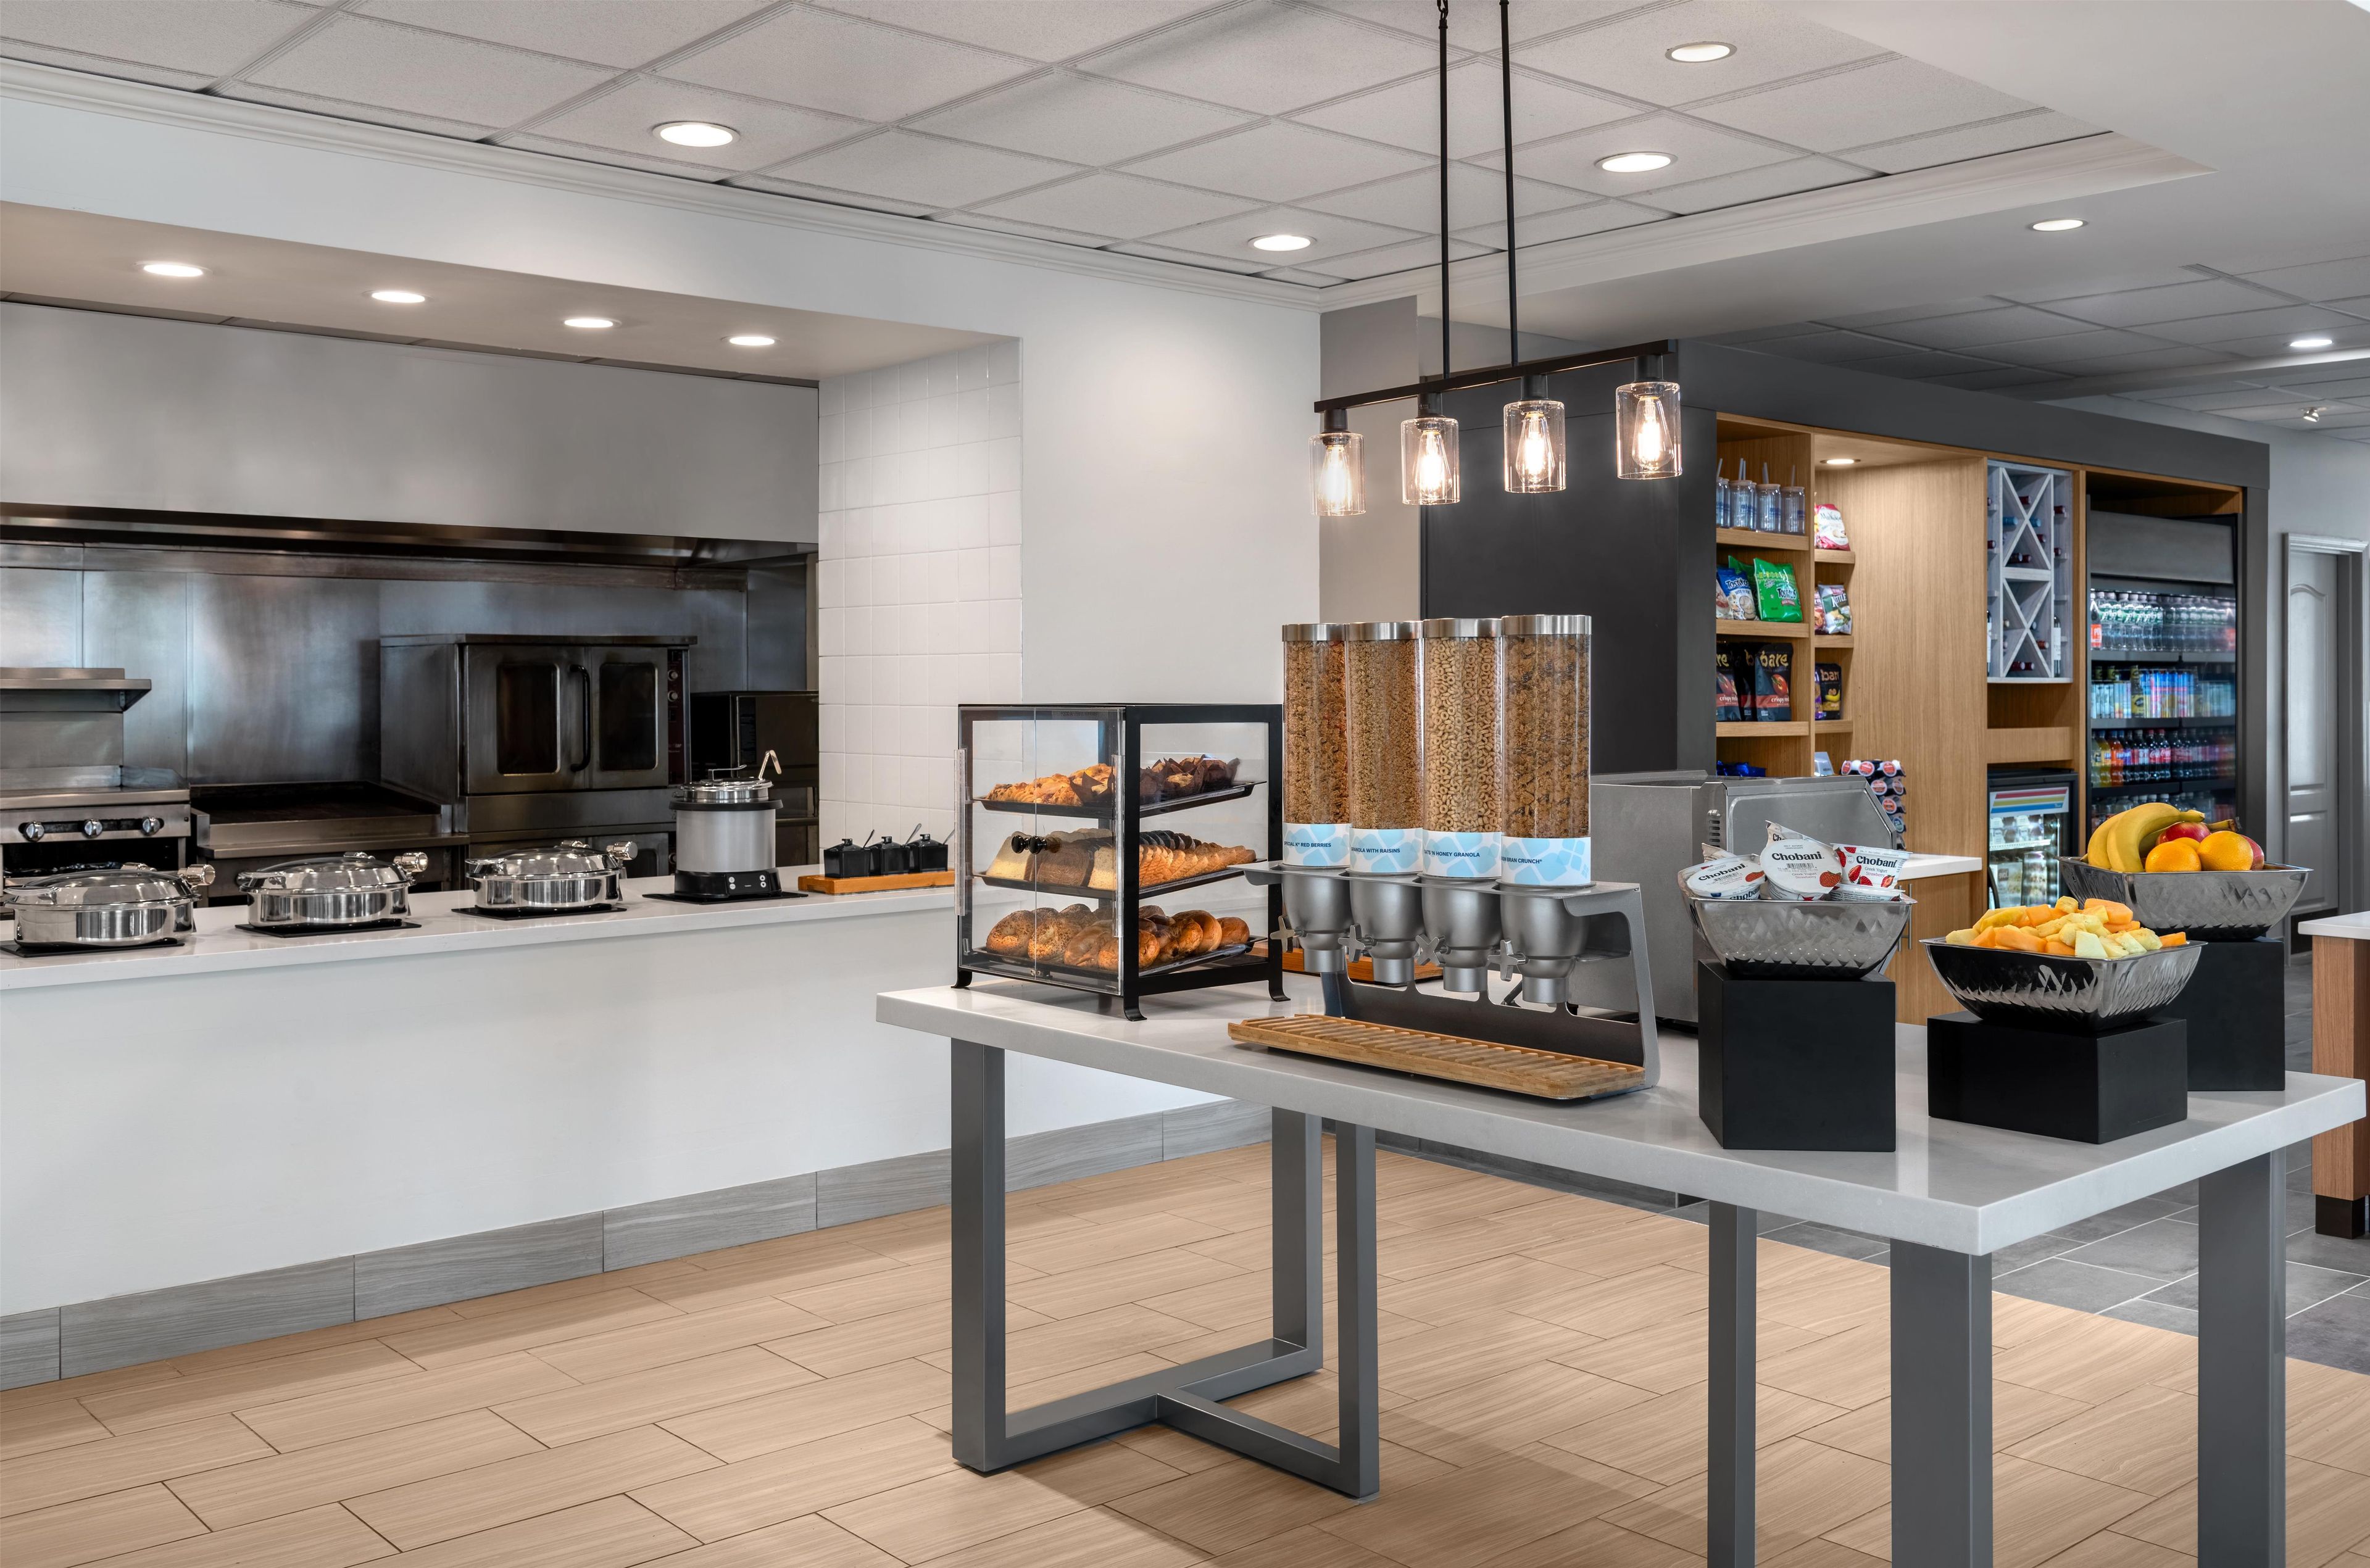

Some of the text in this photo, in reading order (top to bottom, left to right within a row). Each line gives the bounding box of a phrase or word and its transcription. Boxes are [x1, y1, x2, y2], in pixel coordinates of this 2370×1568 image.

[1760, 650, 1789, 667] bare
[1771, 851, 1823, 861] Chobani
[1856, 855, 1898, 868] Chobani
[1698, 863, 1746, 881] Chobani
